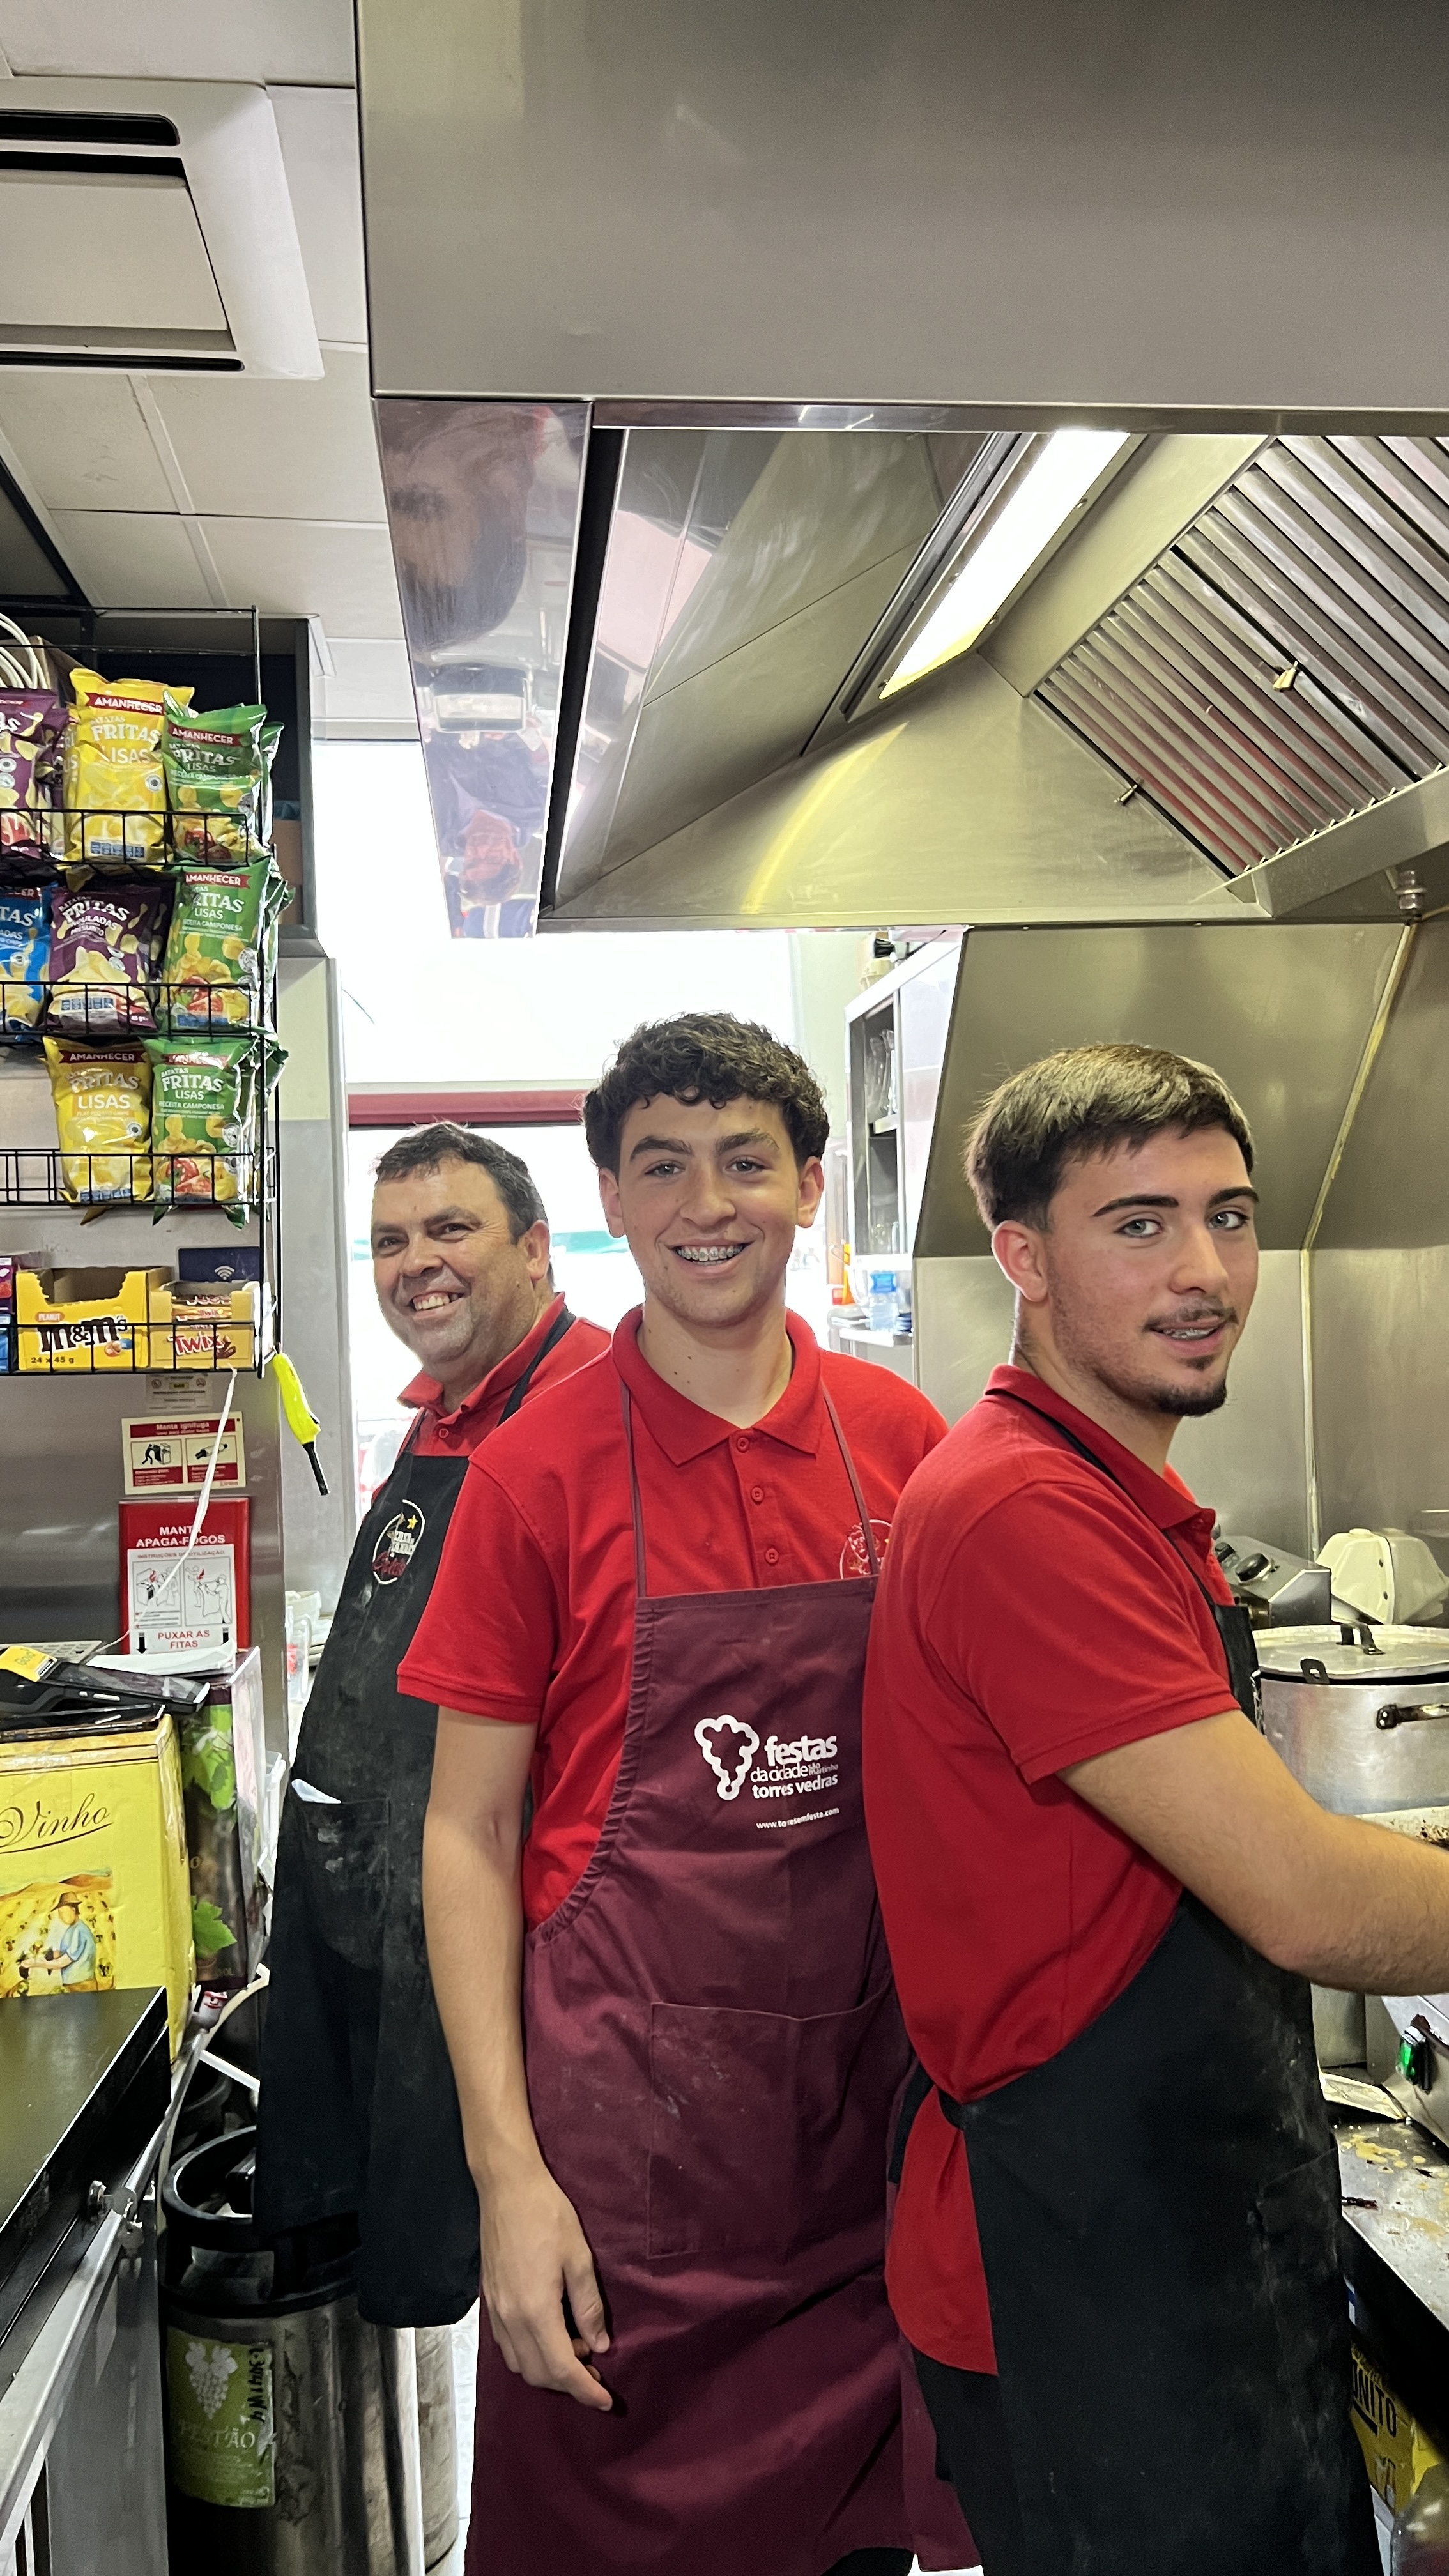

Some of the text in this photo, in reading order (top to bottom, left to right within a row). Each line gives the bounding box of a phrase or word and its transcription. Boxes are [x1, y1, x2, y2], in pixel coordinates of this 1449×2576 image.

[95, 697, 162, 713] AMANHECER
[91, 723, 162, 744] FRITAS
[172, 728, 233, 744] AMANHECER
[101, 746, 151, 764] ISAS
[187, 762, 217, 772] LISAS
[62, 900, 130, 923] FRITAS
[201, 920, 243, 931] CAMPONESA
[70, 1053, 135, 1061] AMANHECER
[161, 1074, 224, 1092] FRITAS
[78, 1094, 130, 1110] LISAS
[175, 1090, 204, 1100] LISAS
[183, 1102, 225, 1110] CAMPONESA
[160, 1525, 202, 1536] MANT
[158, 1631, 194, 1640] PUXAR
[170, 1640, 199, 1649] FITAS
[764, 1735, 838, 1767] festas
[752, 1774, 839, 1799] torres vedras
[0, 1793, 111, 1848] Vinho
